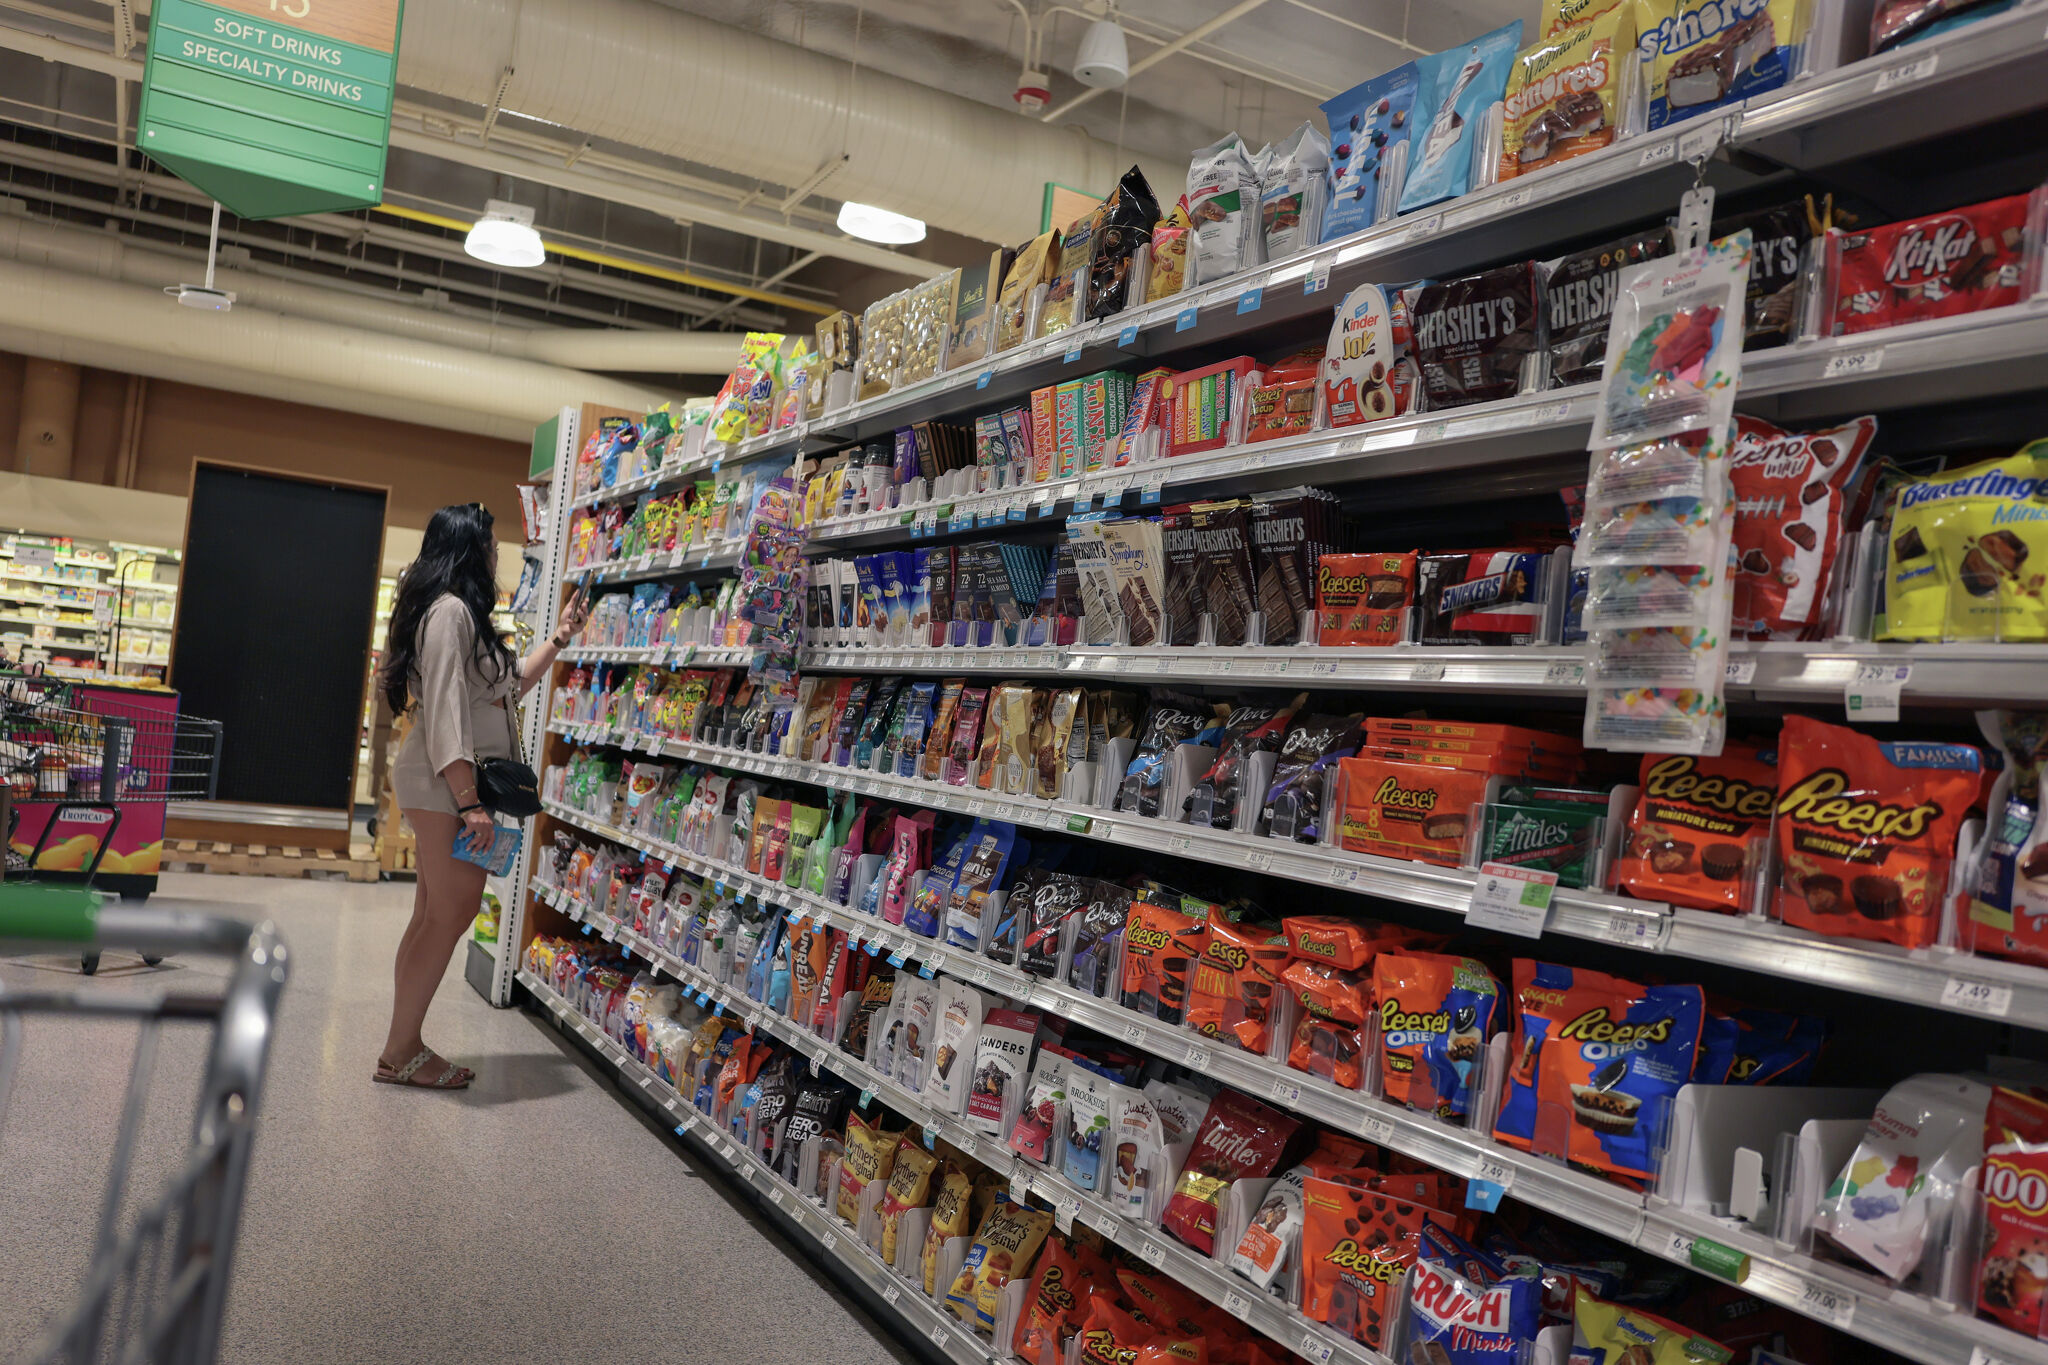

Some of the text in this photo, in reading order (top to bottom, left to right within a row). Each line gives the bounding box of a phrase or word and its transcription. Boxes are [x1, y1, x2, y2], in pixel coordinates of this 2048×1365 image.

[214, 18, 342, 66] SOFT DRINKS
[183, 41, 362, 101] SPECIALTY DRINKS
[1549, 270, 1620, 331] HERSH
[1342, 314, 1380, 334] Kinder
[1417, 296, 1517, 351] HERSHEY'S
[1342, 331, 1375, 360] JOY
[1196, 527, 1242, 553] HERSHEY'S
[1254, 517, 1305, 545] HERSHEY'S
[1072, 540, 1107, 560] HERSHEY'S
[1109, 544, 1149, 571] Symphony
[1057, 567, 1078, 576] RASPBER
[1319, 566, 1368, 595] Reese's
[1440, 577, 1501, 611] SNICKERS
[1155, 708, 1205, 730] Dove
[1225, 707, 1273, 730] Dove
[1281, 728, 1333, 755] Dove
[1373, 776, 1438, 811] Reese's
[1647, 755, 1778, 816] Reese
[62, 807, 104, 822] TROPICAL
[1778, 771, 1938, 837] Reese's
[1368, 809, 1379, 828] 8
[1656, 809, 1735, 834] MINIATURE CUPS
[1500, 820, 1569, 855] Andes
[886, 832, 909, 902] UNREAL
[962, 860, 994, 879] minis
[1036, 884, 1083, 910] Dove
[1127, 917, 1171, 950] Reese's
[1300, 933, 1337, 957] Reese's
[796, 928, 812, 995] UNREAL
[1208, 940, 1250, 970] ese's
[819, 940, 844, 1007] UNREAL
[1457, 973, 1491, 991] SHARE
[1522, 987, 1567, 1007] SNACK
[1953, 982, 1990, 999] 7.49
[1380, 997, 1451, 1035] Reese's
[1560, 1008, 1675, 1044] Reese's
[980, 1035, 1027, 1057] SANDERS
[1384, 1031, 1435, 1048] OREO
[1580, 1037, 1648, 1063] OREO
[980, 1101, 1001, 1113] CARAME
[1070, 1086, 1107, 1112] BROOKSIDE
[845, 1131, 880, 1171] Werther's
[1202, 1114, 1264, 1168] Turtles
[848, 1153, 876, 1182] Original
[1479, 1161, 1503, 1178] 7.49
[1985, 1164, 2047, 1211] 100
[987, 1206, 1031, 1241] Werther's
[984, 1224, 1022, 1254] Original
[1672, 1238, 1693, 1252] 6.4
[1131, 1279, 1155, 1301] SNACK
[1339, 1271, 1376, 1298] minis
[1303, 1338, 1318, 1352] 6.99
[1452, 1322, 1517, 1353] Minis
